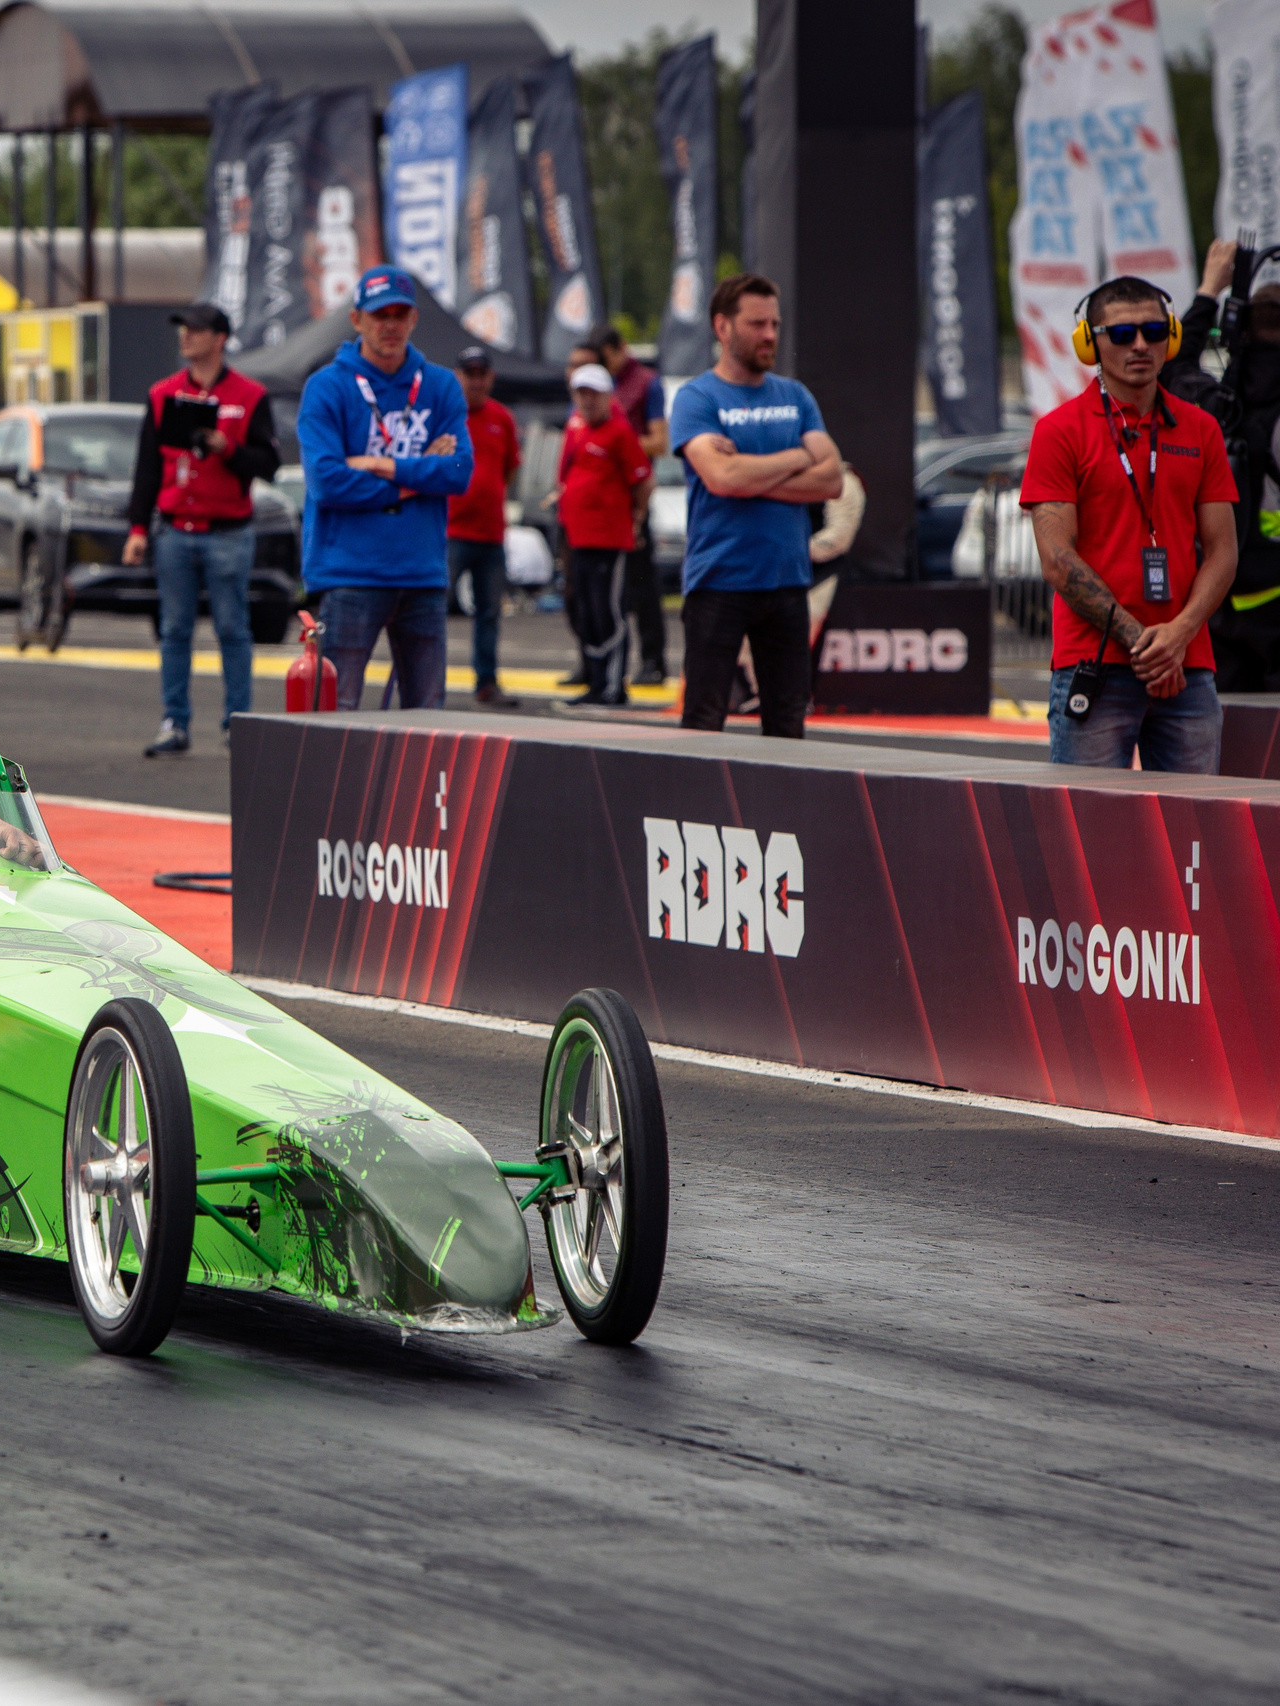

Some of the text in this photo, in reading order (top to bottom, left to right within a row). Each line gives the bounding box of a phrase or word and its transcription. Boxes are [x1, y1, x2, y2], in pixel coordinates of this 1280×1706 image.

[318, 838, 448, 909] ROSGONKI
[643, 817, 805, 958] RDRC
[1018, 916, 1200, 1005] ROSGONKI
